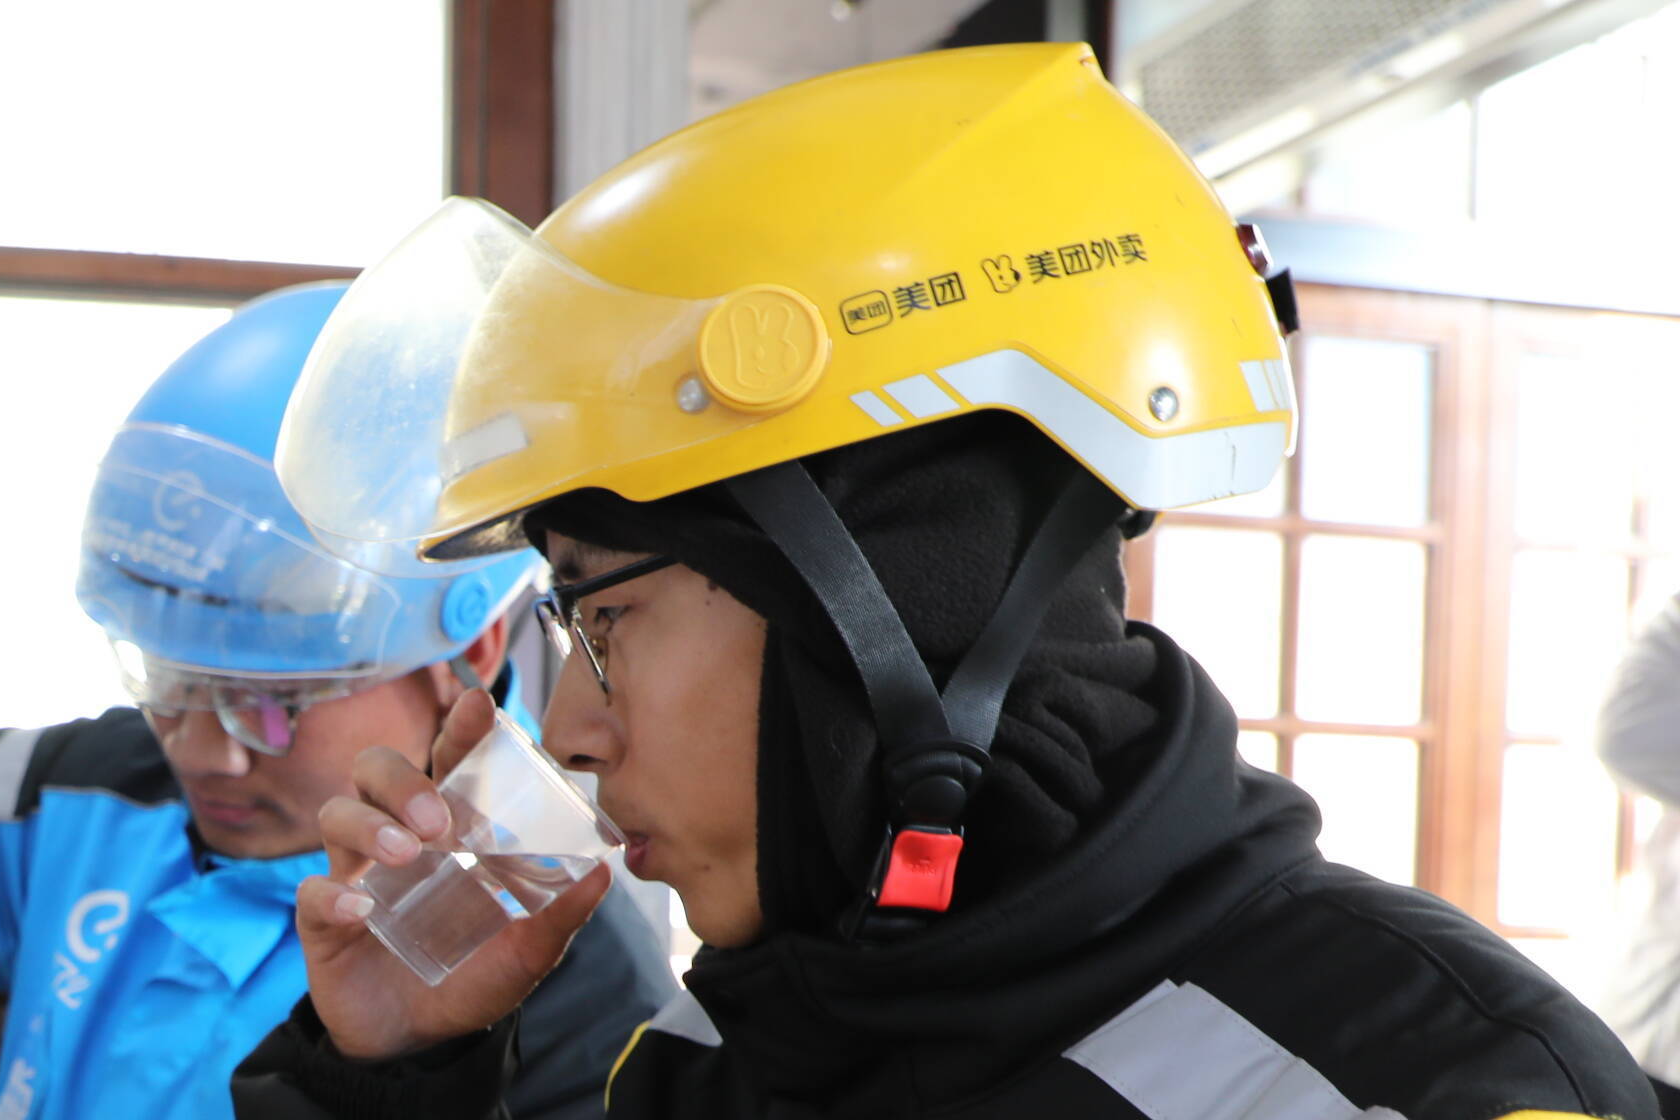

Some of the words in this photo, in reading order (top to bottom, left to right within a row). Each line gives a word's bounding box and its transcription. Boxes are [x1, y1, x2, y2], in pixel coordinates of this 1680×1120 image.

[846, 300, 887, 325] 美团
[892, 272, 966, 318] 美团
[1025, 233, 1148, 284] 美团外卖
